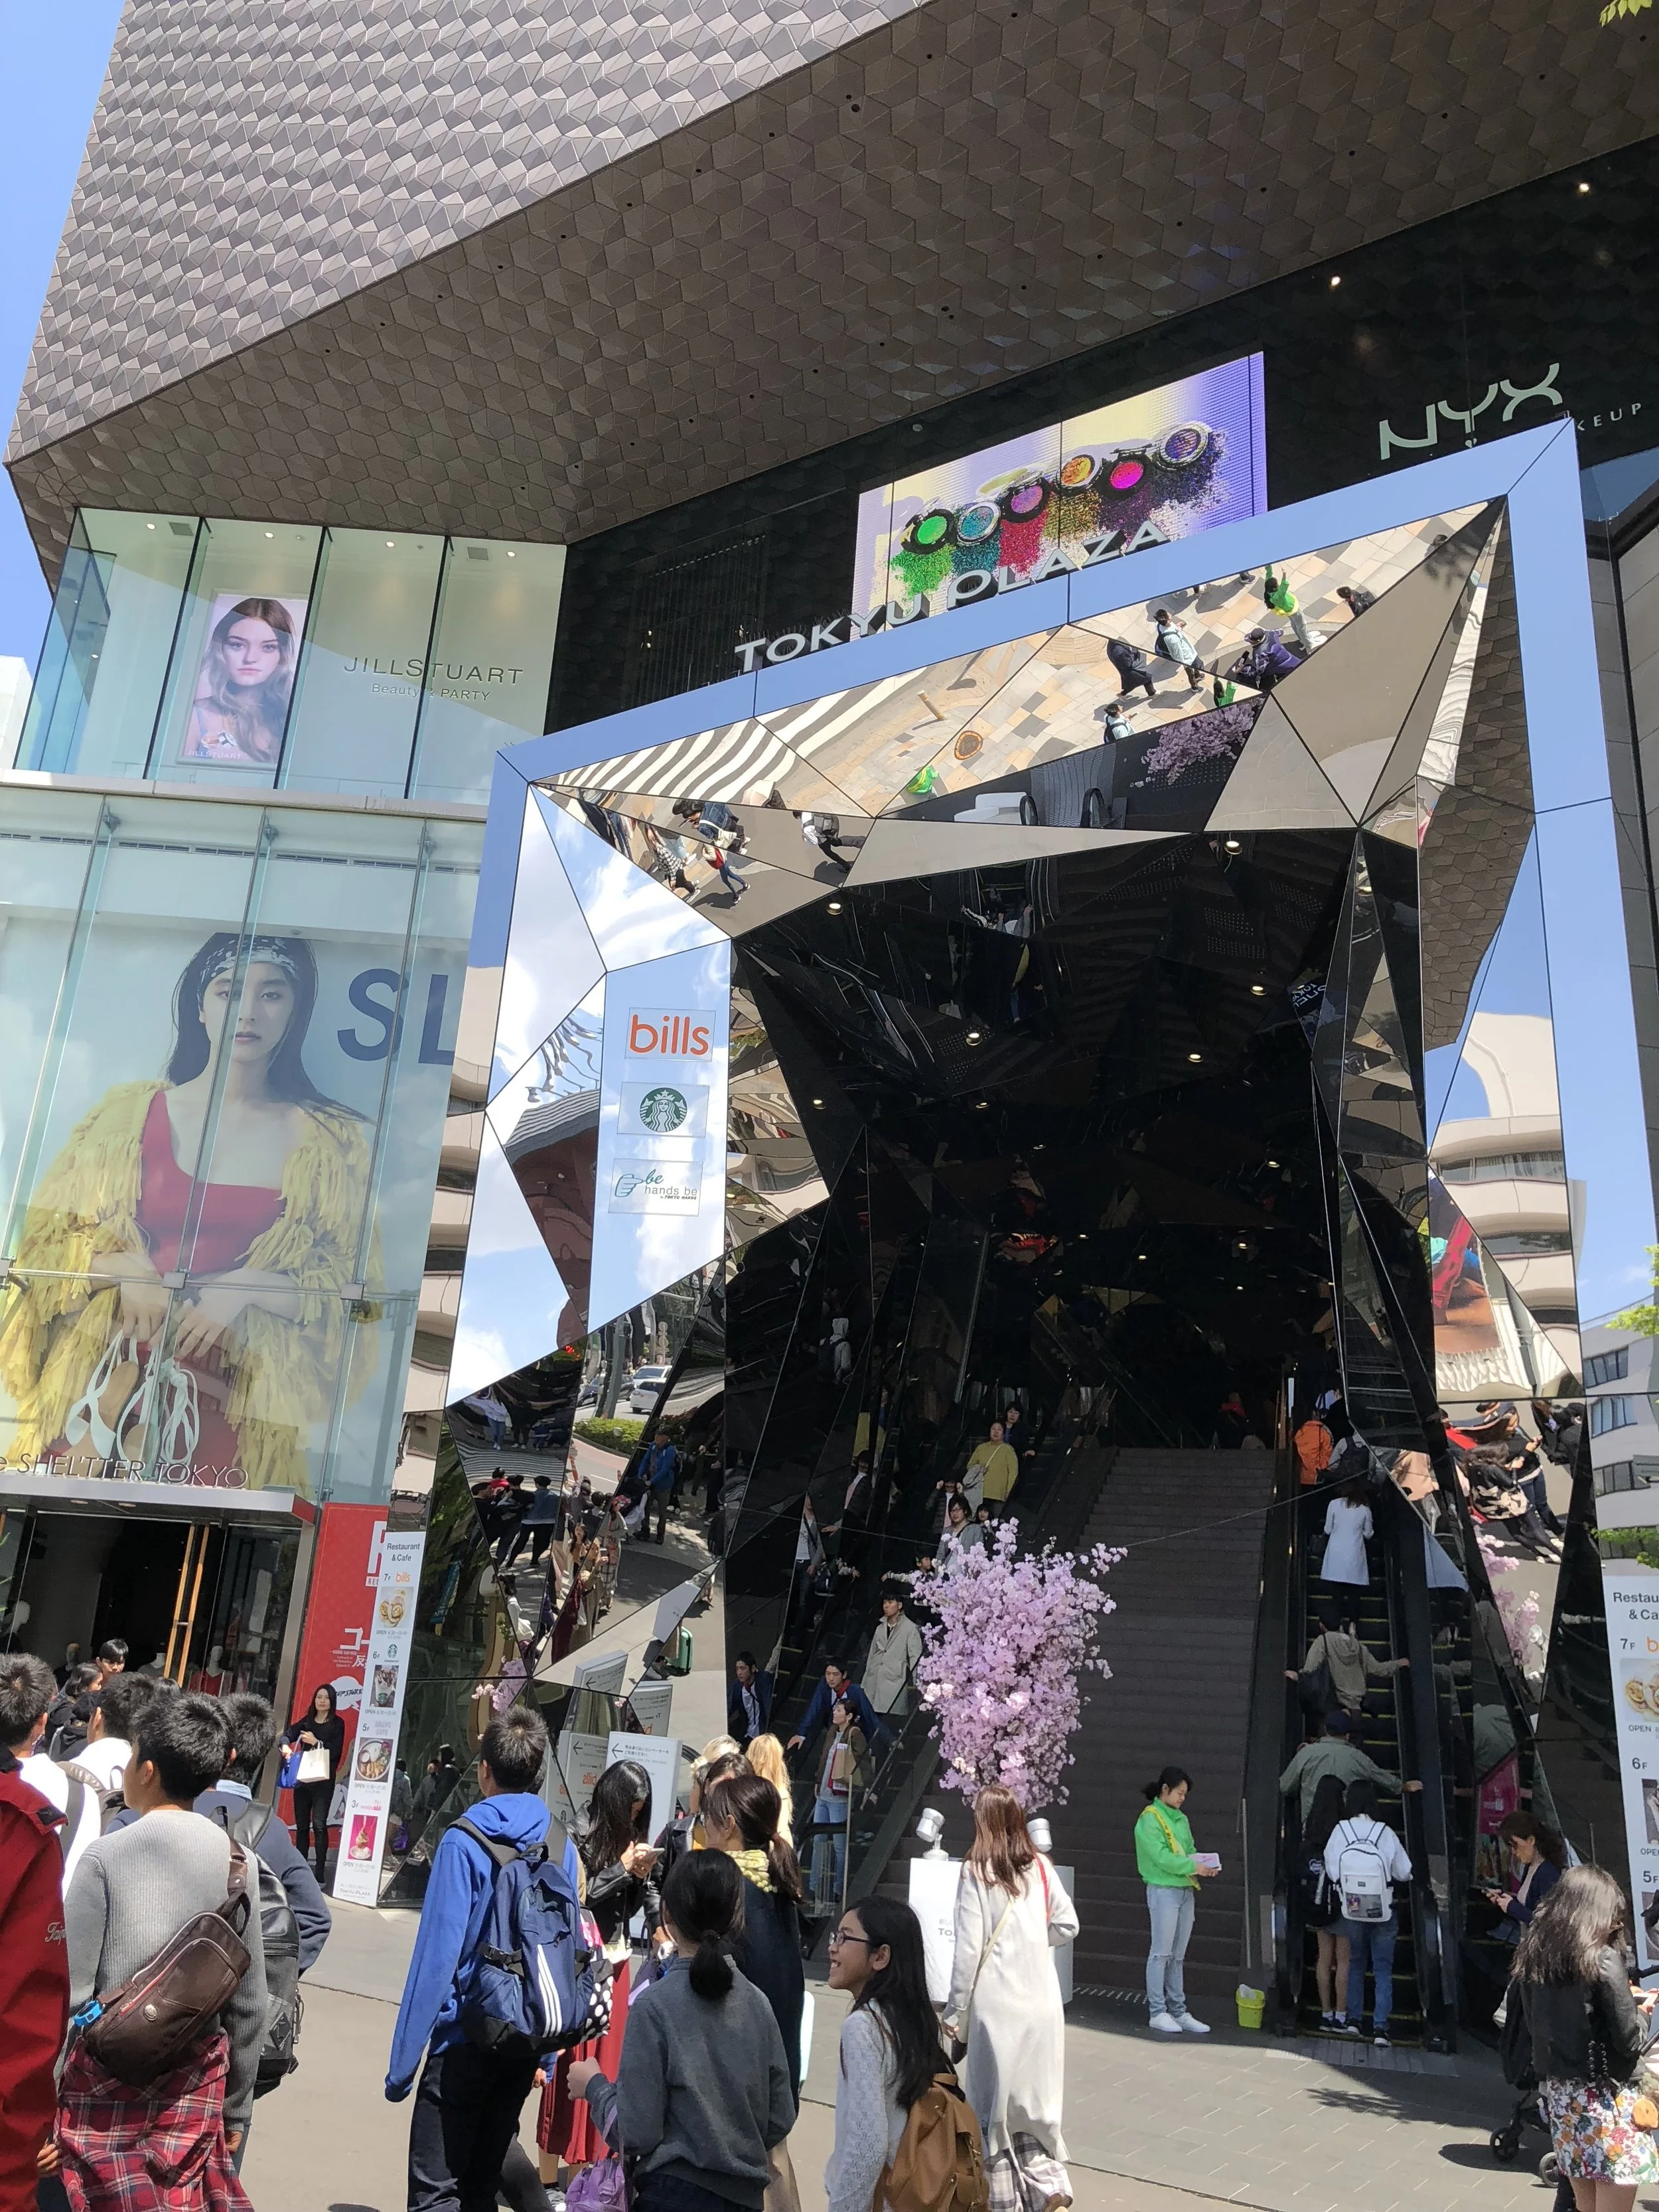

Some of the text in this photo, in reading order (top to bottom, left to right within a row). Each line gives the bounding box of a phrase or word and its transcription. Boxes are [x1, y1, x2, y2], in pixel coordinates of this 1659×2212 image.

[1379, 362, 1563, 460] NYX
[734, 519, 1170, 673] TOKYU PLAZA
[344, 656, 524, 684] JILLSTUART
[372, 683, 419, 698] Beauty
[441, 688, 492, 701] PARTY
[186, 750, 242, 759] JILLSTUART
[629, 1013, 710, 1055] bills
[644, 1168, 664, 1185] be
[644, 1185, 698, 1196] hands be
[155, 1462, 249, 1489] TOKYO
[384, 1571, 411, 1583] 7F bills
[1628, 1609, 1638, 1620] &
[1620, 1637, 1636, 1650] 7F
[352, 1655, 367, 1668] 反
[372, 1651, 380, 1660] 6F
[1632, 1757, 1648, 1770] 6F
[1643, 1870, 1659, 1883] 5F
